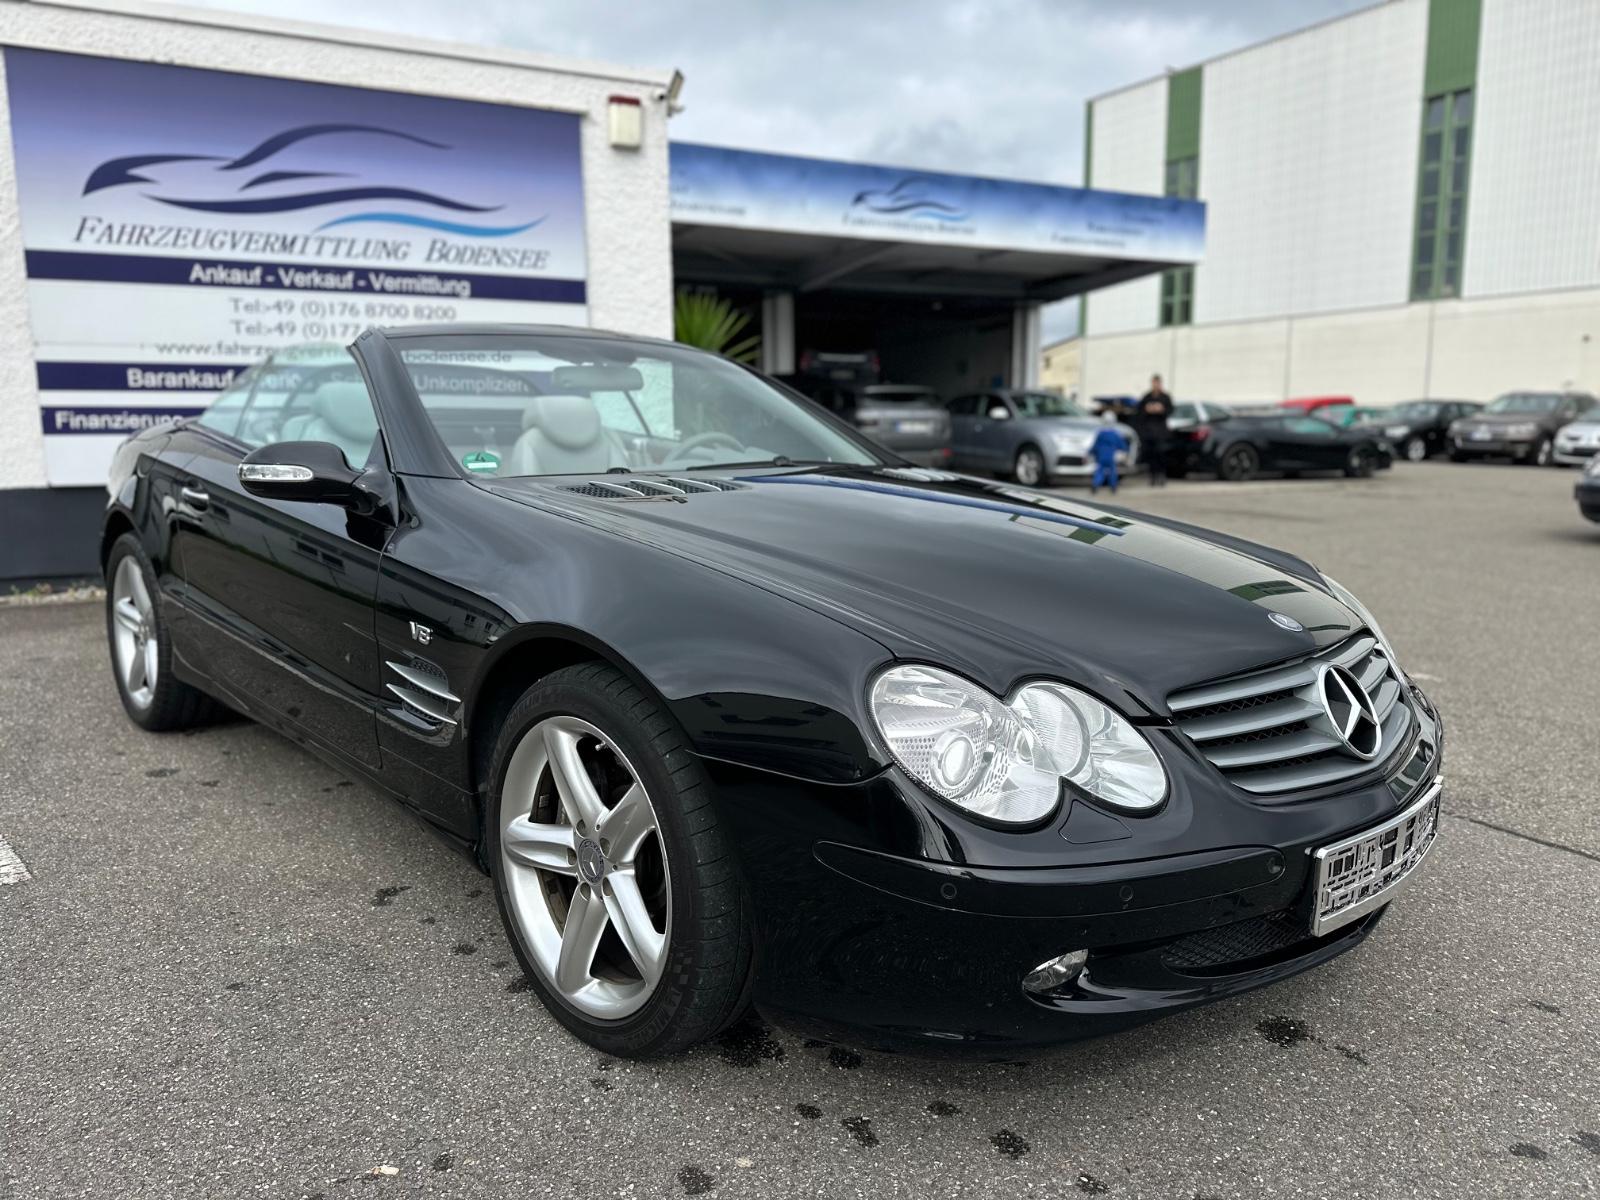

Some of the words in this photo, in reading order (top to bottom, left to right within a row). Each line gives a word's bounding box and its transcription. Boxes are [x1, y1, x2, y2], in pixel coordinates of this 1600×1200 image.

[424, 237, 551, 270] BODENSEE
[188, 262, 263, 285] Ankauf
[277, 266, 355, 290] Verkauf
[368, 272, 472, 298] Vermittlung
[300, 300, 361, 318] (0)176
[364, 302, 410, 319] 8700
[413, 303, 457, 321] 8200
[125, 367, 236, 389] Barankauf
[408, 620, 434, 646] V8
